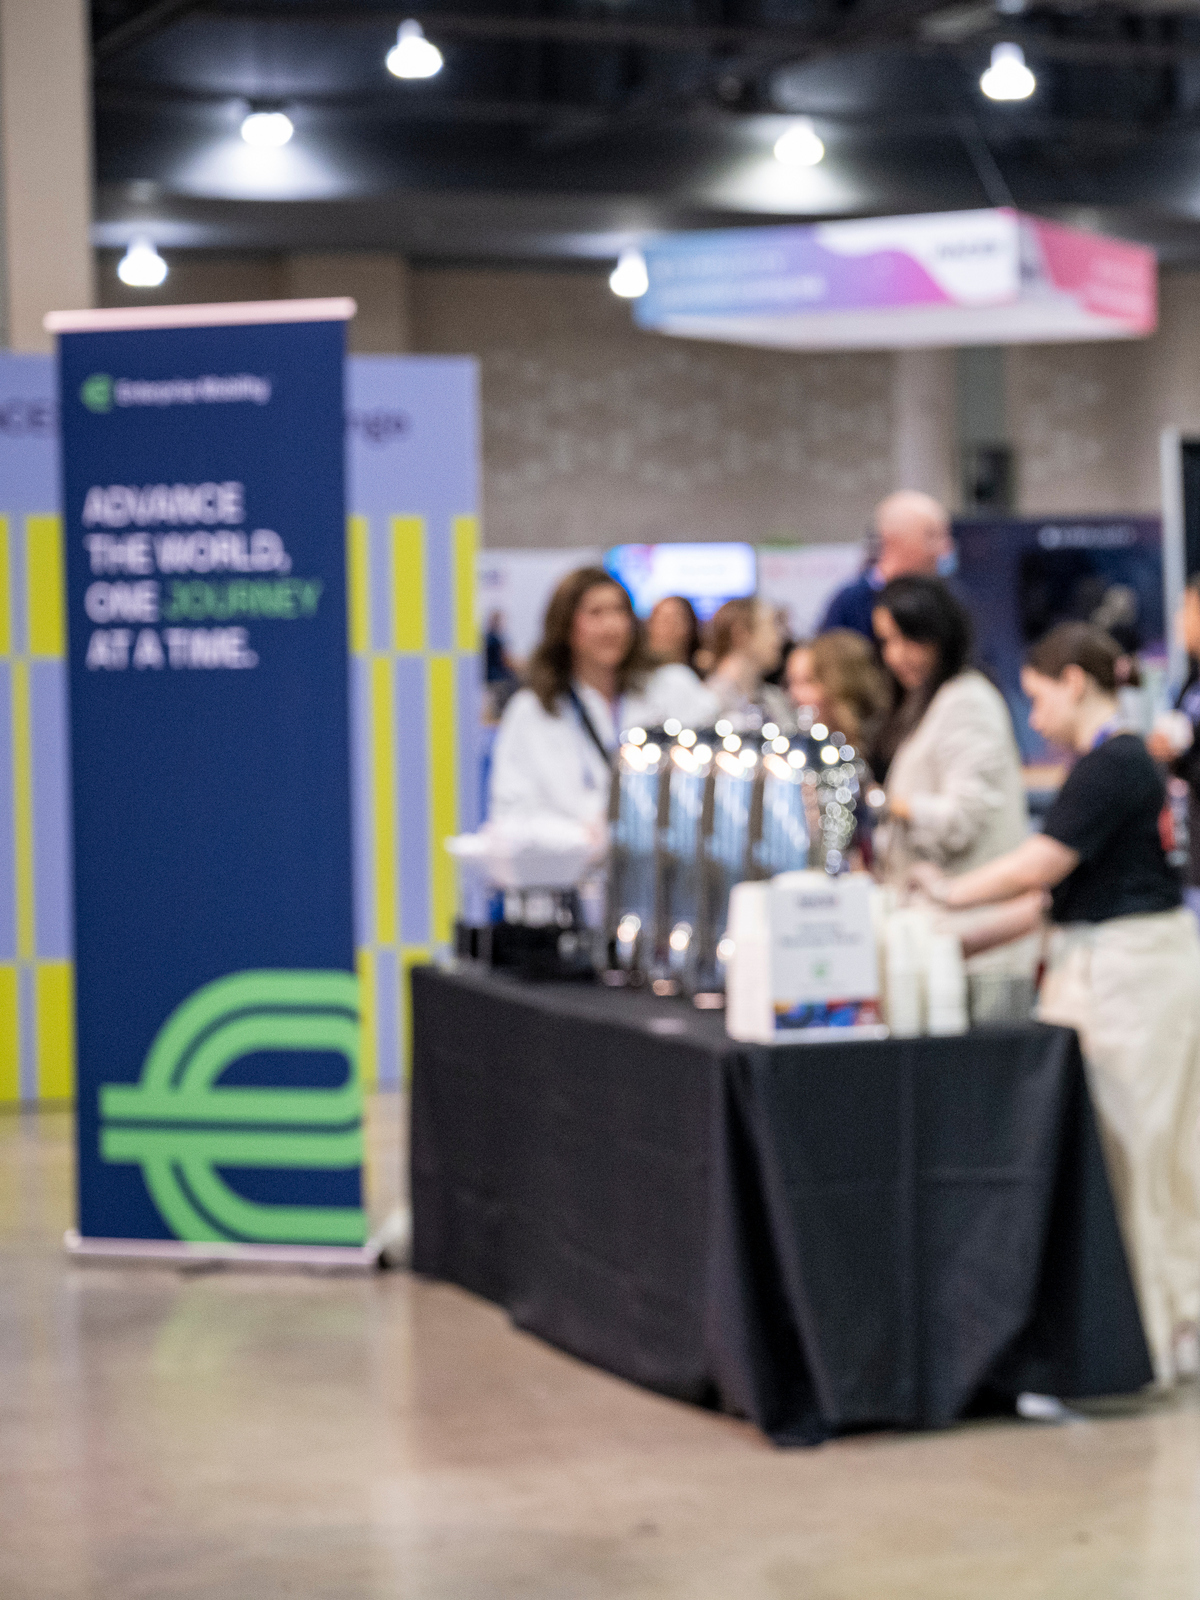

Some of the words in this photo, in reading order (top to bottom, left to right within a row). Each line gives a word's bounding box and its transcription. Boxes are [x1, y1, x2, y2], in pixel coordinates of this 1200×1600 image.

[83, 482, 244, 527] ADVANCE
[84, 532, 153, 574] THE
[85, 580, 160, 623] ONE
[161, 578, 322, 620] JOURNEY
[85, 628, 132, 670] AT
[133, 628, 165, 670] A
